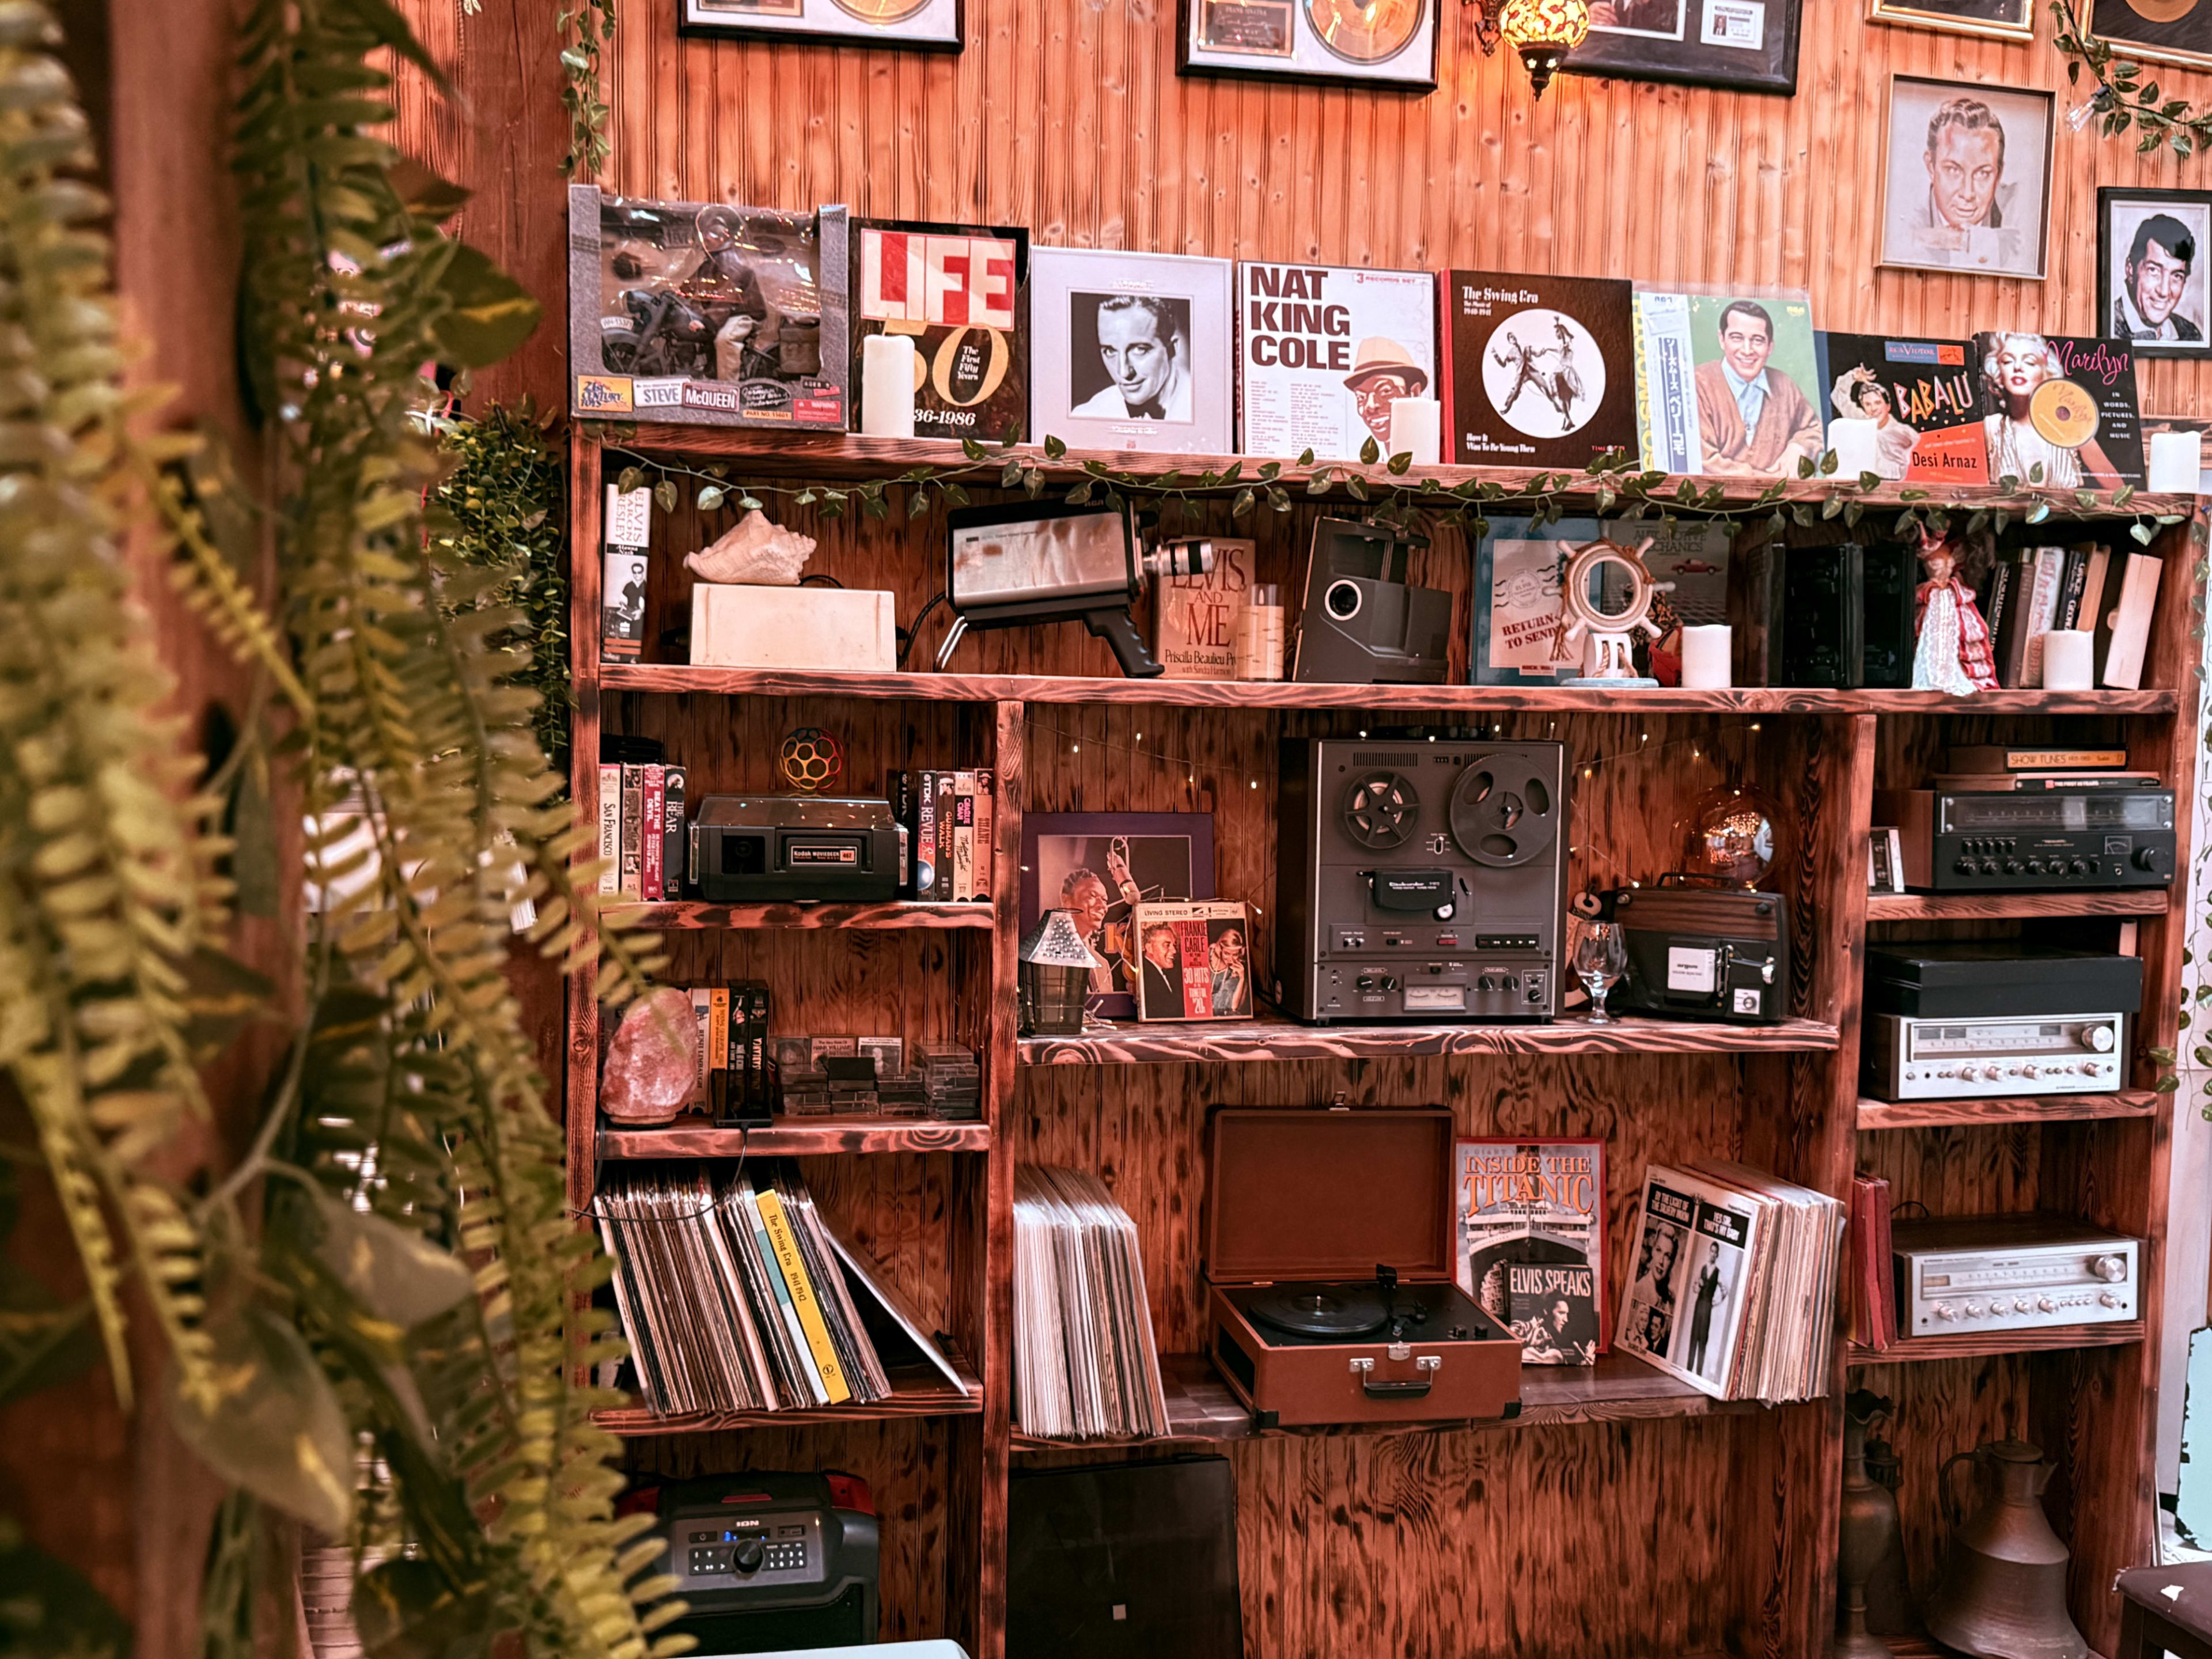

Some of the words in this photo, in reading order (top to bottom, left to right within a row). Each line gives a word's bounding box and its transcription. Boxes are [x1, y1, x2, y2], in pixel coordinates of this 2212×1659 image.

[862, 232, 1013, 329] LIFE
[1251, 266, 1328, 300] NAT
[1356, 273, 1364, 283] 3
[1462, 286, 1482, 300] The
[1483, 287, 1518, 305] Swing
[1519, 289, 1539, 304] Era
[1251, 301, 1350, 336] KING
[961, 354, 980, 363] First
[963, 346, 979, 354] The
[1252, 335, 1350, 370] COLE
[959, 363, 979, 374] Fifty
[2040, 340, 2128, 385] Marilyn
[957, 371, 979, 381] Years
[644, 388, 679, 403] STEVE
[685, 389, 737, 408] McQUEEN
[1912, 452, 1938, 467] Desi
[1942, 452, 1978, 469] Arnaz
[615, 494, 626, 542] RESLEY
[634, 490, 645, 543] ELVIS
[1634, 529, 1706, 541] AUTOOTIVE
[1637, 541, 1703, 552] ECHANICS
[1195, 591, 1224, 603] AND
[1186, 603, 1231, 647] ME
[1502, 613, 1555, 637] RETURN
[2065, 600, 2076, 630] GEORG
[1505, 635, 1522, 649] TO
[1524, 624, 1565, 645] SEND
[1165, 649, 1192, 663] Priscilla
[1194, 651, 1225, 666] Beaulieu
[2011, 755, 2036, 764] SHOW
[2040, 754, 2066, 764] TUNES
[923, 780, 931, 804] TDK
[604, 803, 615, 820] SAN
[665, 801, 677, 834] BEAR
[676, 801, 684, 817] THE
[963, 797, 971, 825] CHARLIE
[921, 806, 934, 844] REVUE
[978, 817, 990, 844] SHANE
[603, 820, 616, 856] FRANCISCO
[1180, 921, 1207, 937] FRANKIE
[1184, 937, 1206, 953] CARLE
[1183, 967, 1193, 984] 30
[1193, 967, 1209, 984] HITS
[1465, 1156, 1541, 1173] INSIDE
[1547, 1157, 1591, 1173] THE
[1463, 1175, 1594, 1218] TITANIC
[768, 1213, 778, 1227] The
[773, 1228, 787, 1252] Swing
[782, 1252, 792, 1266] Era
[1510, 1267, 1543, 1294] ELVIS
[1545, 1268, 1592, 1297] SPEAKS
